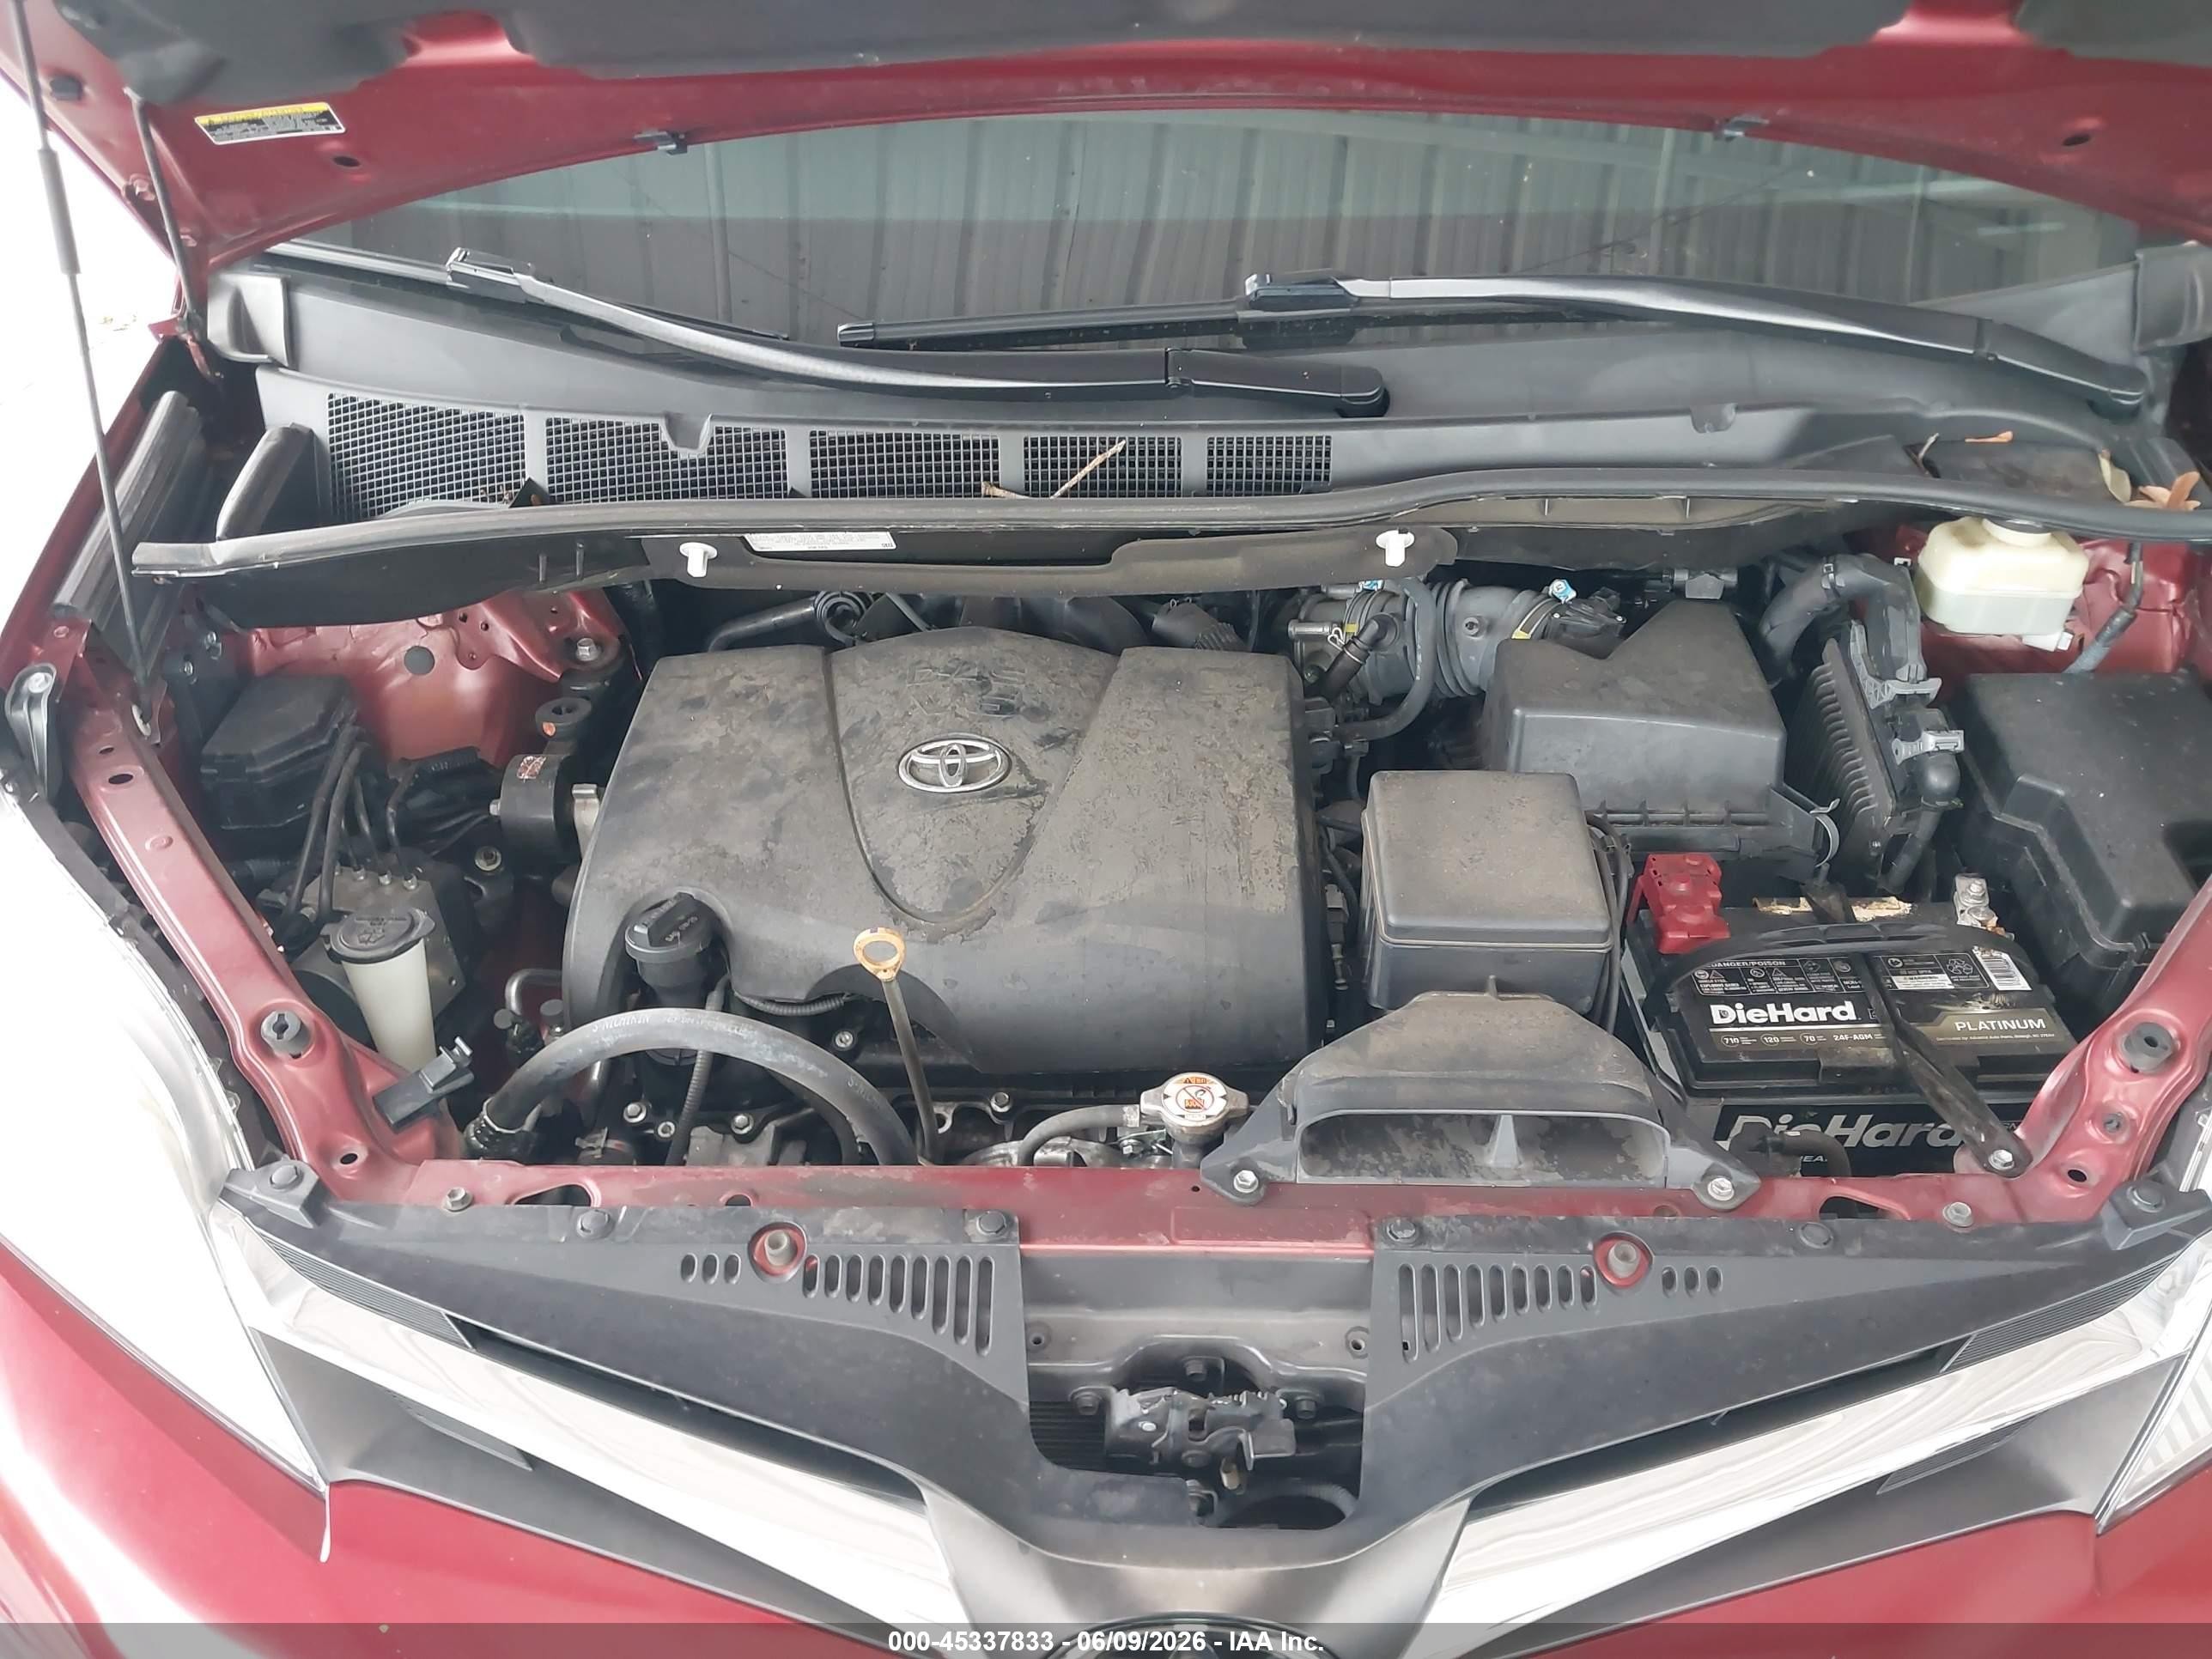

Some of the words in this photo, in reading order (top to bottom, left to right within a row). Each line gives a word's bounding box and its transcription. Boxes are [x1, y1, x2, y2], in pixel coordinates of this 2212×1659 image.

[1710, 1000, 1856, 1024] DieHard
[1954, 1018, 2046, 1031] PLATINUM
[1832, 1033, 1874, 1042] 24F-AGM
